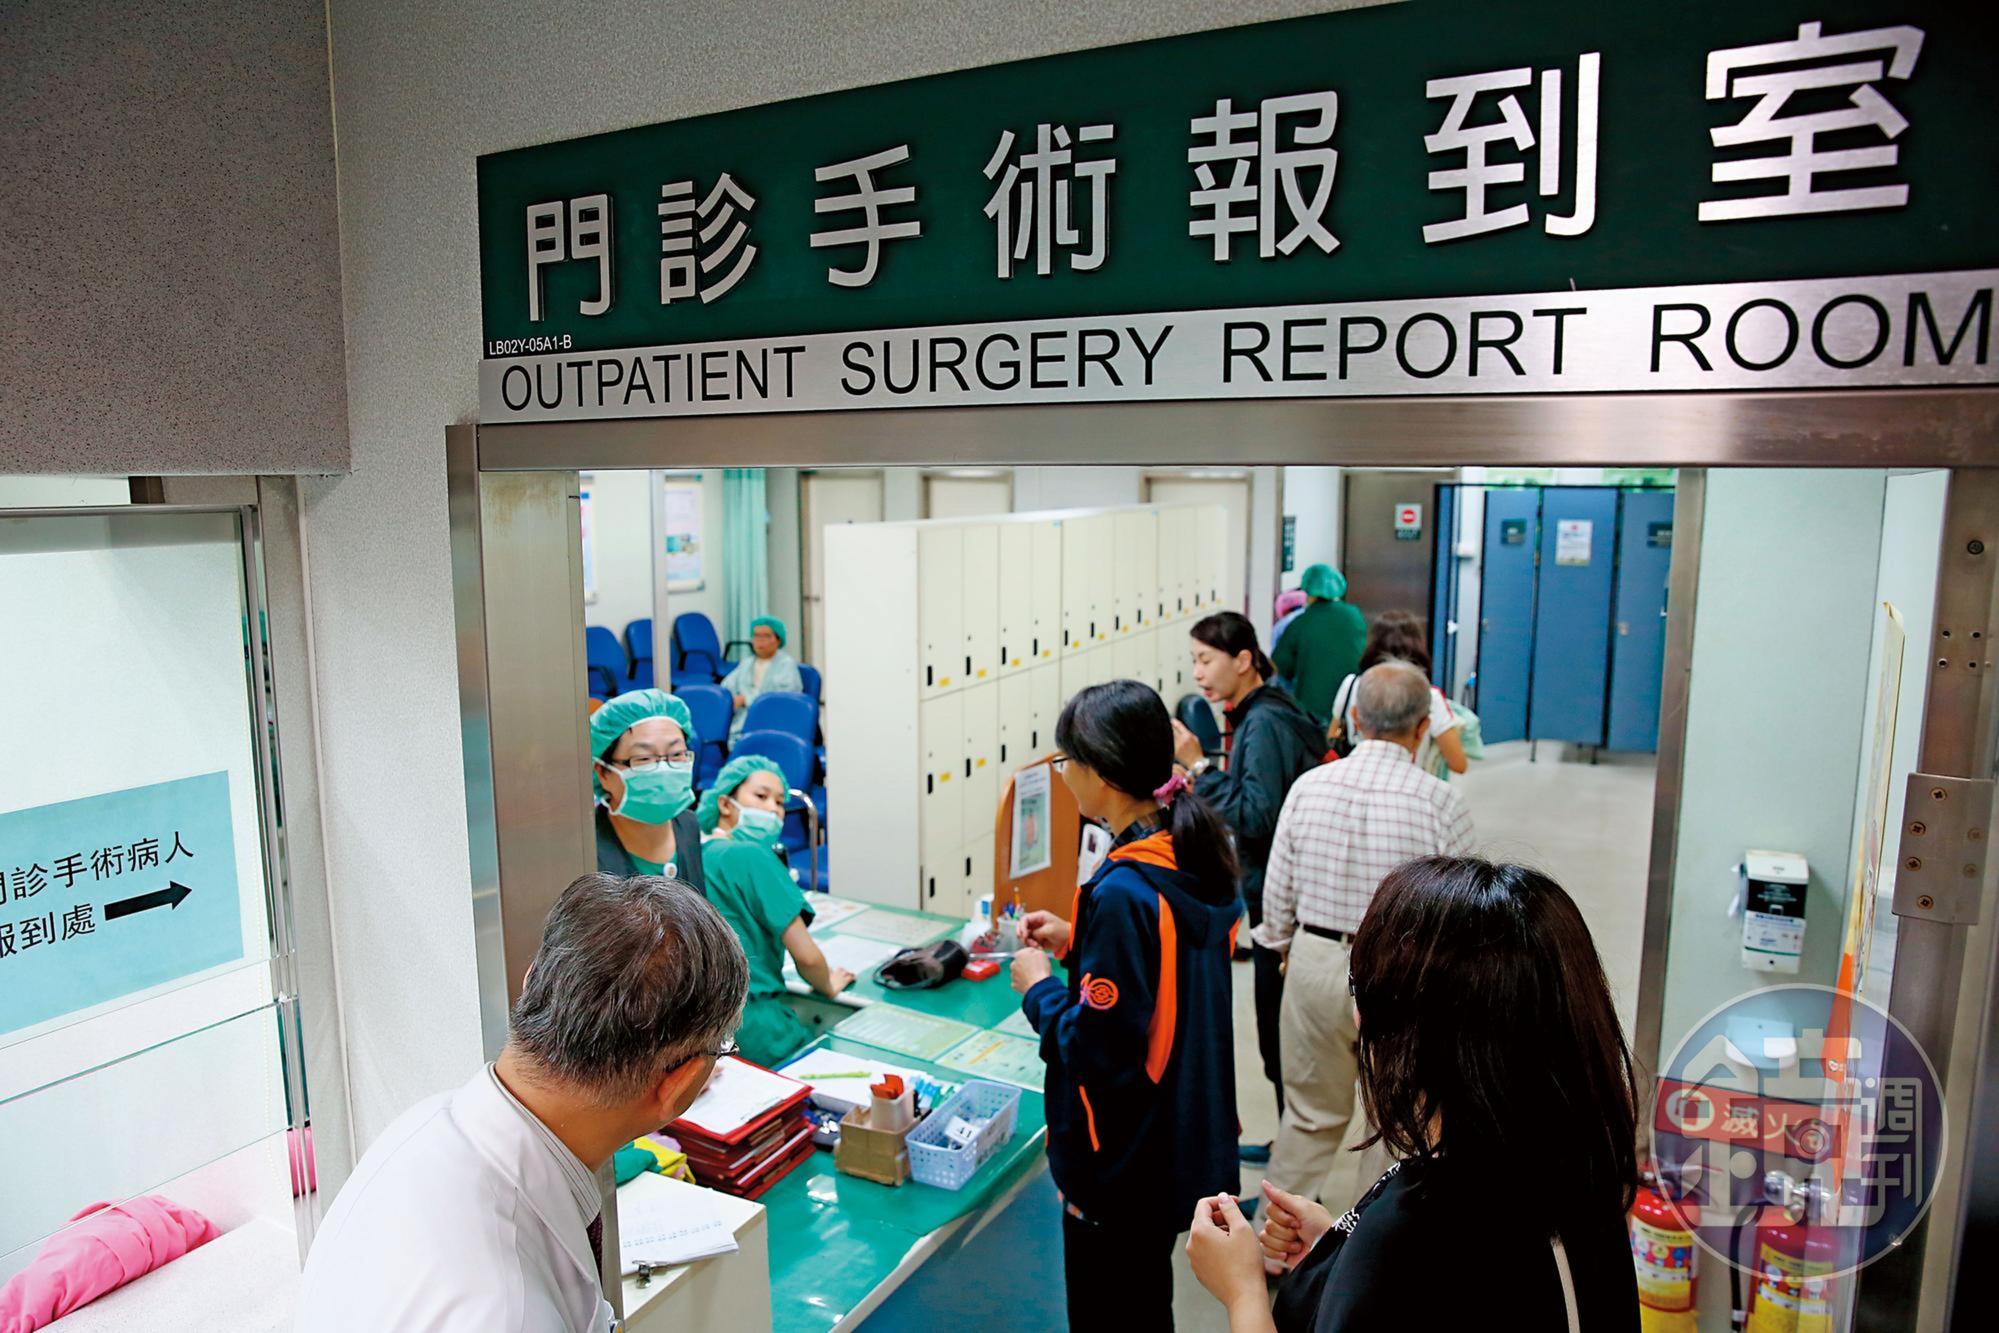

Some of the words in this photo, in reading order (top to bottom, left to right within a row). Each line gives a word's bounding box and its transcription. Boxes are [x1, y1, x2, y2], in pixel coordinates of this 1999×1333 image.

[526, 20, 1926, 323] 門診手術報到室
[488, 334, 573, 356] LB02Y-05A1-B
[500, 345, 807, 412] OUTPATIENT
[841, 325, 1174, 395] SURGERY
[1222, 307, 1587, 383] REPORT
[1650, 289, 1994, 372] ROOM
[0, 831, 194, 905] 診手術病人
